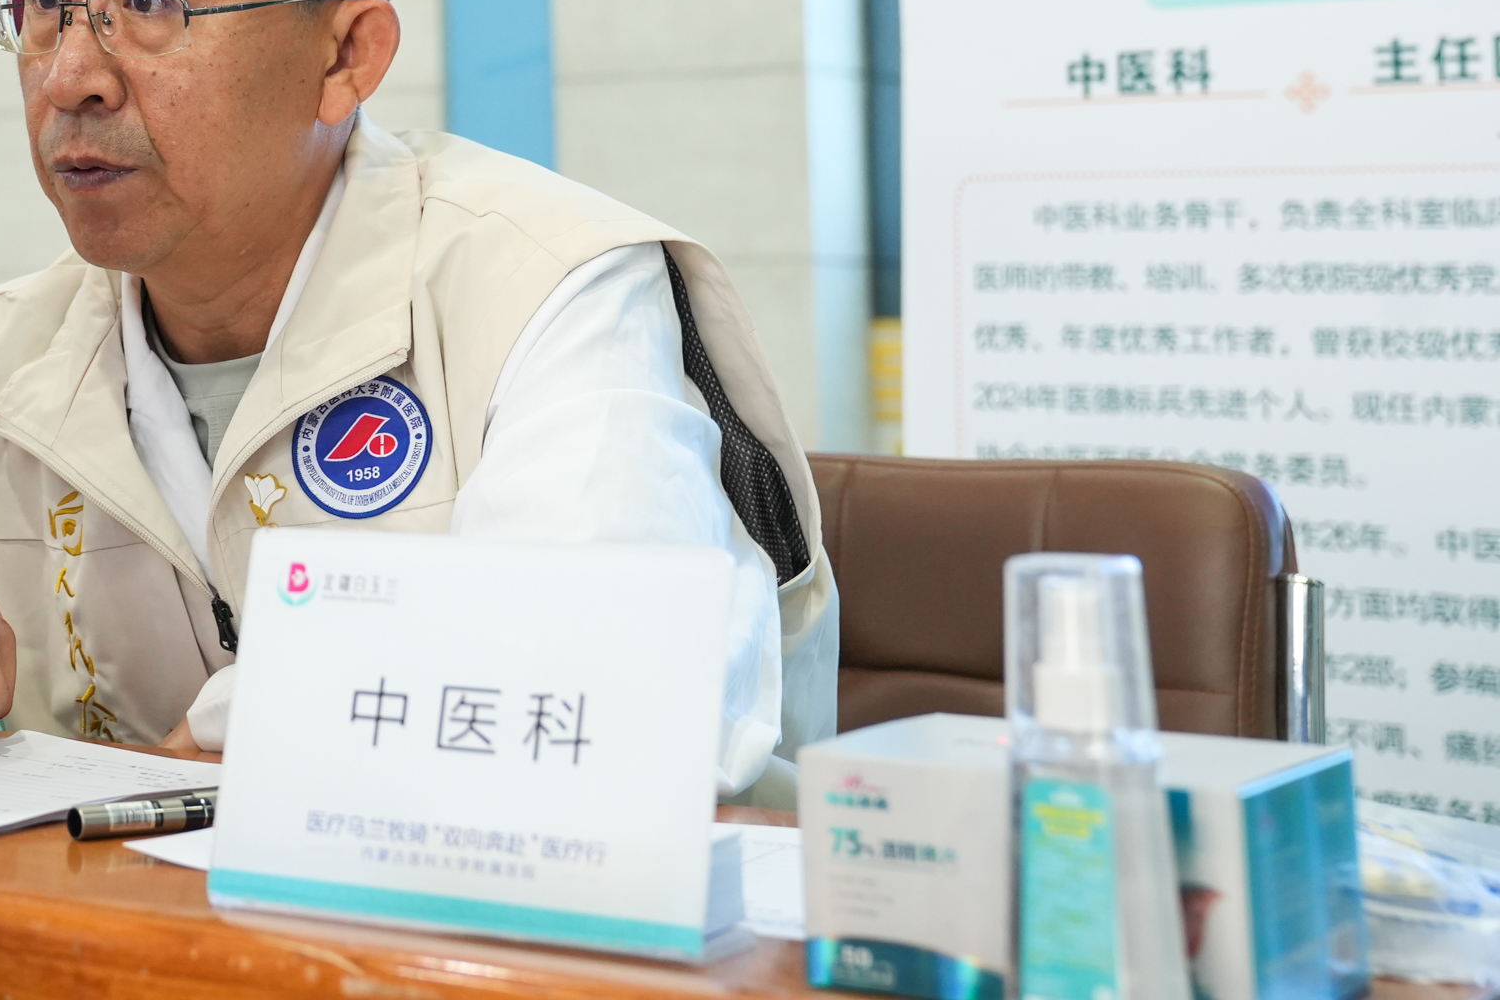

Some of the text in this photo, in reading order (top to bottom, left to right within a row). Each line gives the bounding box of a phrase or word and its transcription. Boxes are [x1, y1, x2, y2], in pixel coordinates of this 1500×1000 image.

[1067, 33, 1500, 98] 中医科 主任
[972, 381, 1500, 429] 2024年医德标兵先进个人。现任内蒙
[346, 465, 380, 483] 1958
[349, 676, 592, 766] 中医科
